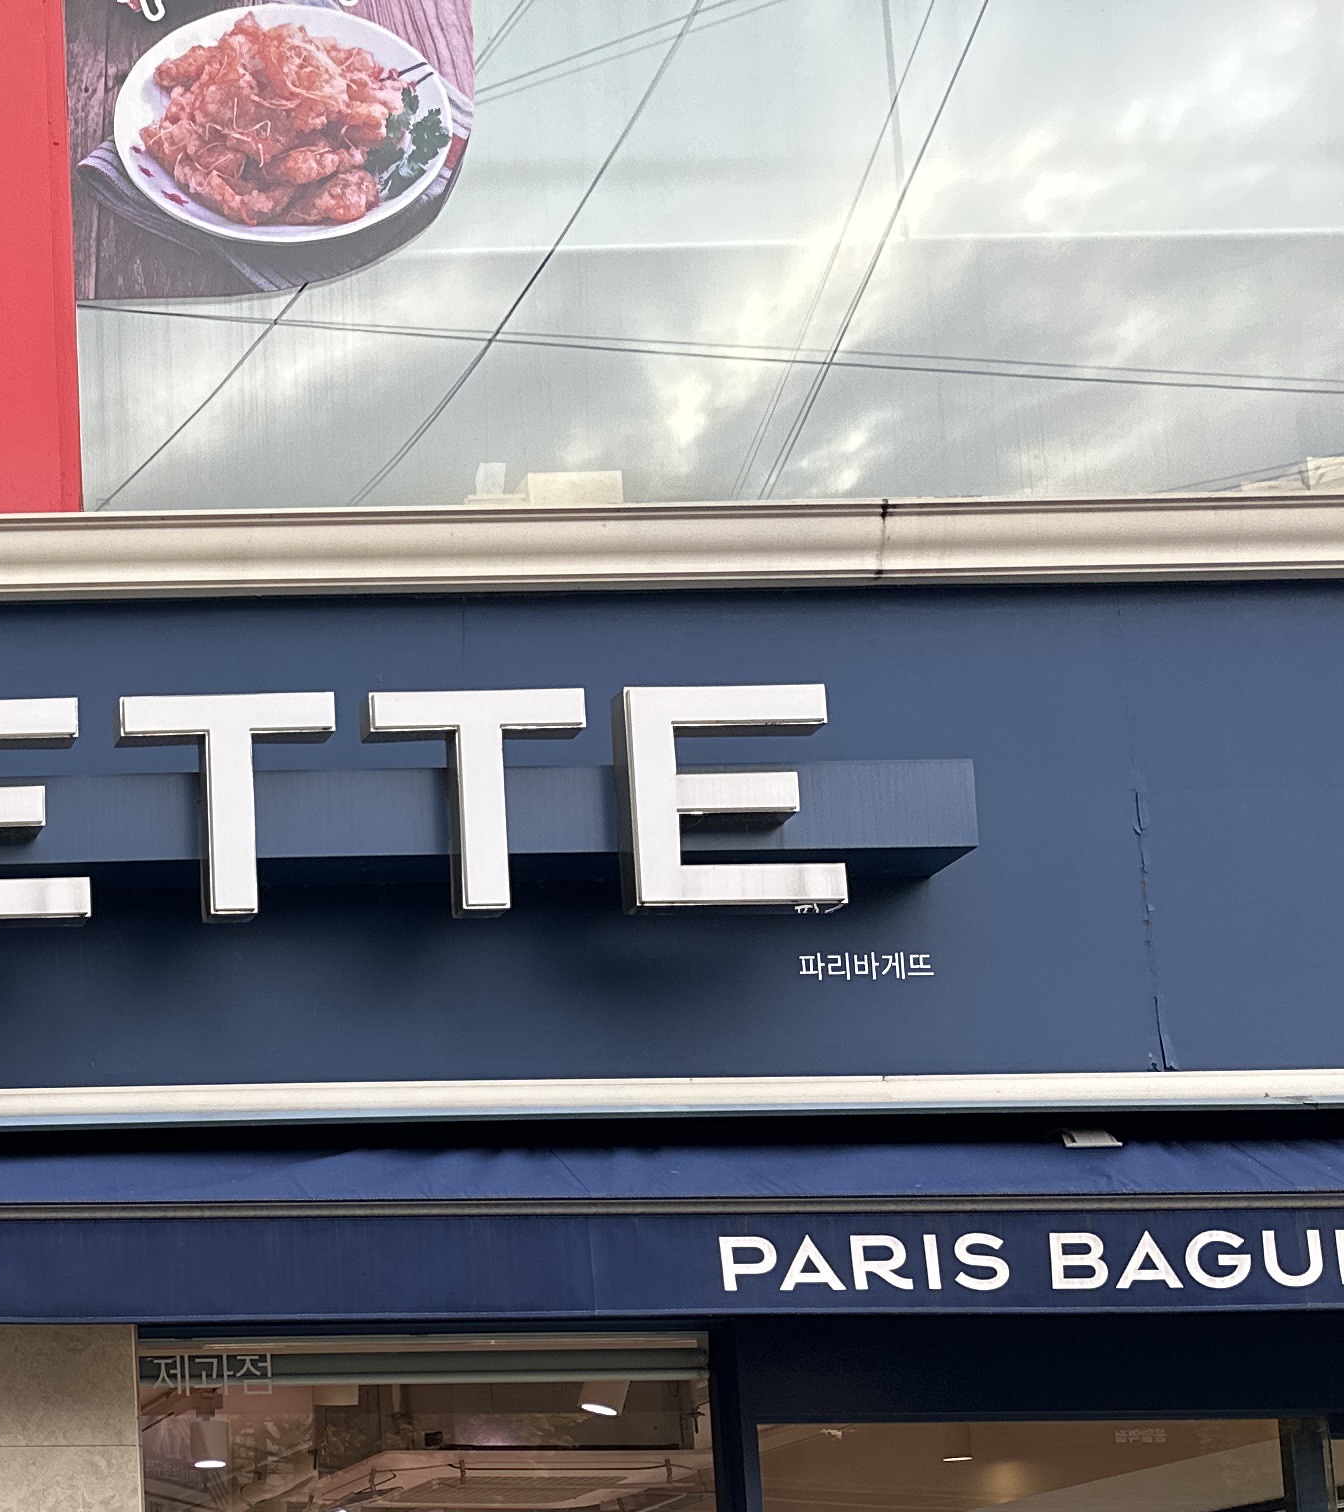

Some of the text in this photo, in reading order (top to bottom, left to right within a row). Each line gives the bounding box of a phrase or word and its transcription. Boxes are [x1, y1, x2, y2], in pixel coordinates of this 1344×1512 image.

[799, 951, 935, 981] 파리바게뜨
[719, 1229, 1344, 1292] PARIS BAGU
[153, 1353, 273, 1396] 제과점
